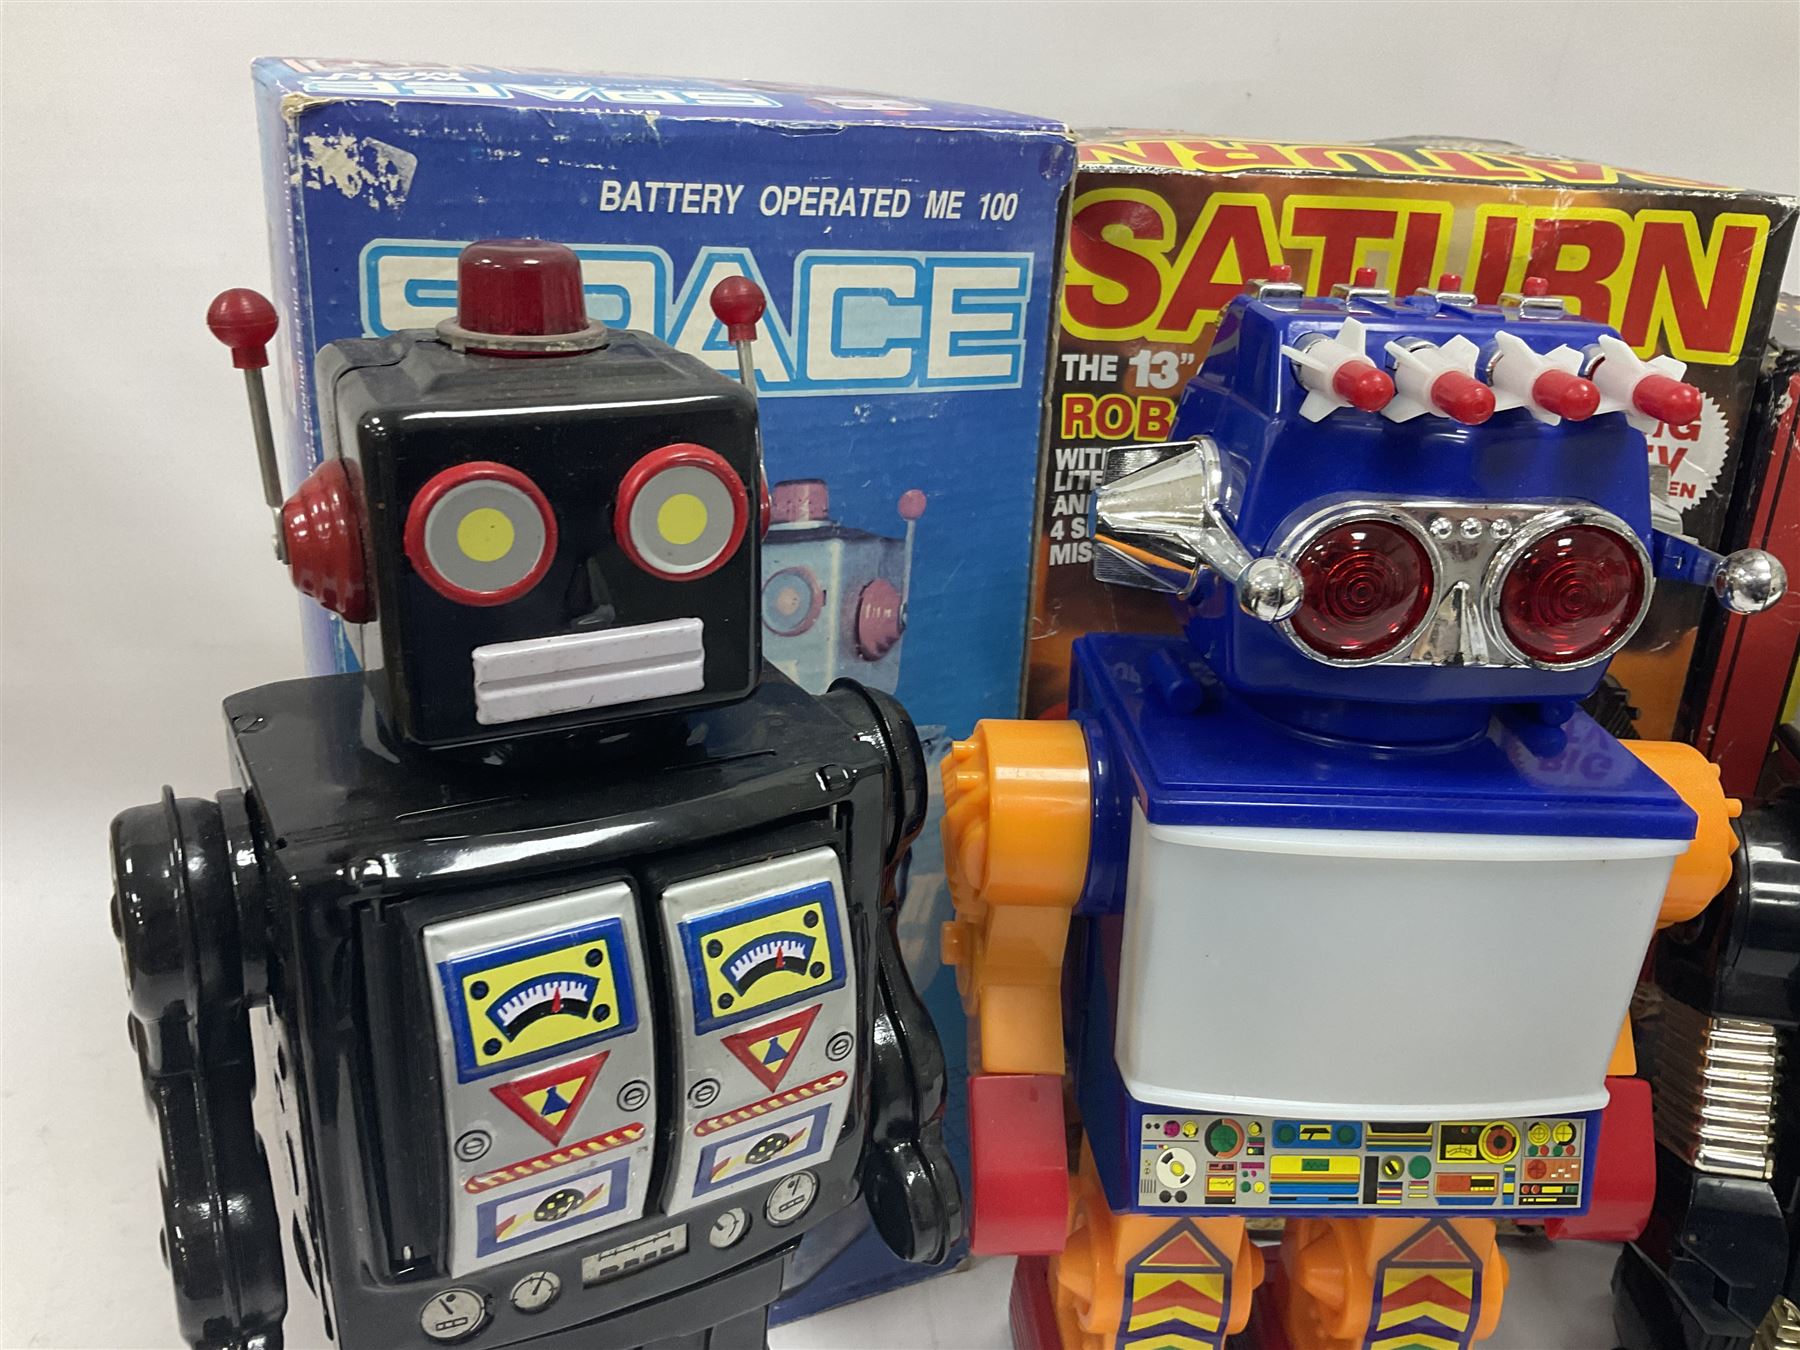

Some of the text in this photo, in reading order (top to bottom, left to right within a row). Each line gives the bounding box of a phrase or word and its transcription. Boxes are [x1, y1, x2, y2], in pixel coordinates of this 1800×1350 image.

[302, 80, 783, 108] SPACE
[1078, 140, 1746, 191] ATURN
[599, 179, 1018, 222] BATTERY OPERATED ME 100
[1061, 187, 1771, 365] SATURN
[1061, 353, 1119, 382] THE
[1647, 444, 1689, 477] V
[1051, 495, 1089, 518] AN
[1049, 520, 1065, 541] 4
